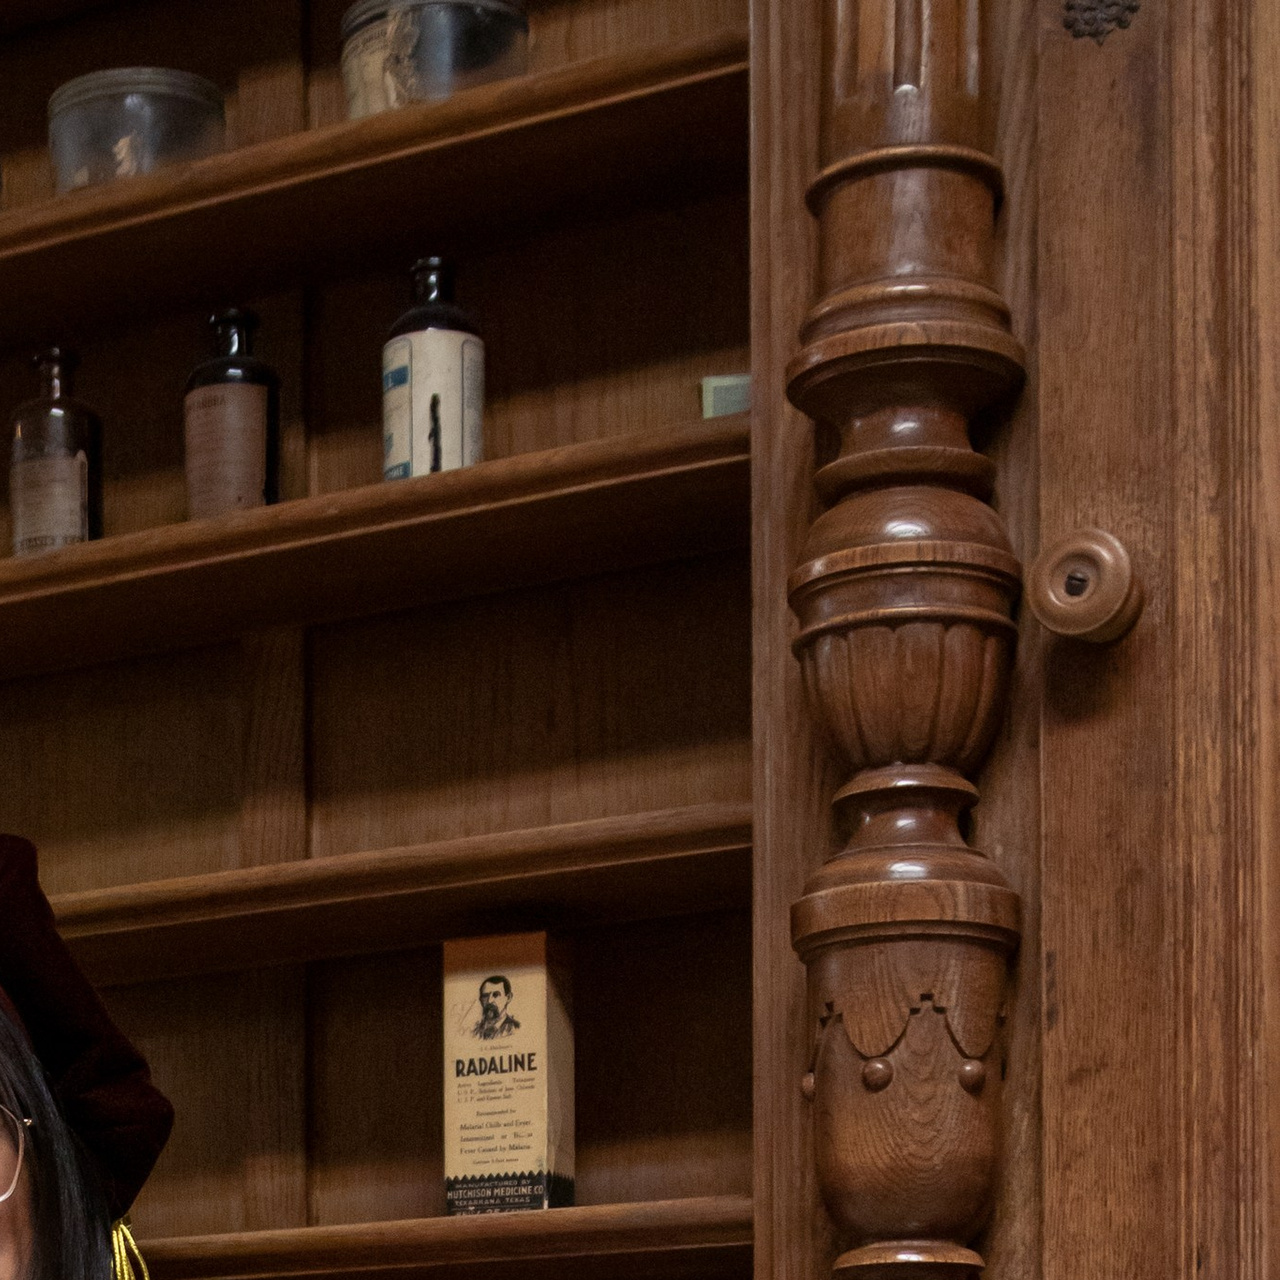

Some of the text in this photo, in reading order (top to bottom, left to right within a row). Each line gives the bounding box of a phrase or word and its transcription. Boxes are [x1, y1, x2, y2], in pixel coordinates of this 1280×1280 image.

[456, 1052, 538, 1078] RADALINE
[455, 1179, 518, 1189] MANUFACTURED
[447, 1187, 492, 1200] HUTCHISON
[493, 1185, 533, 1197] MEDICINE
